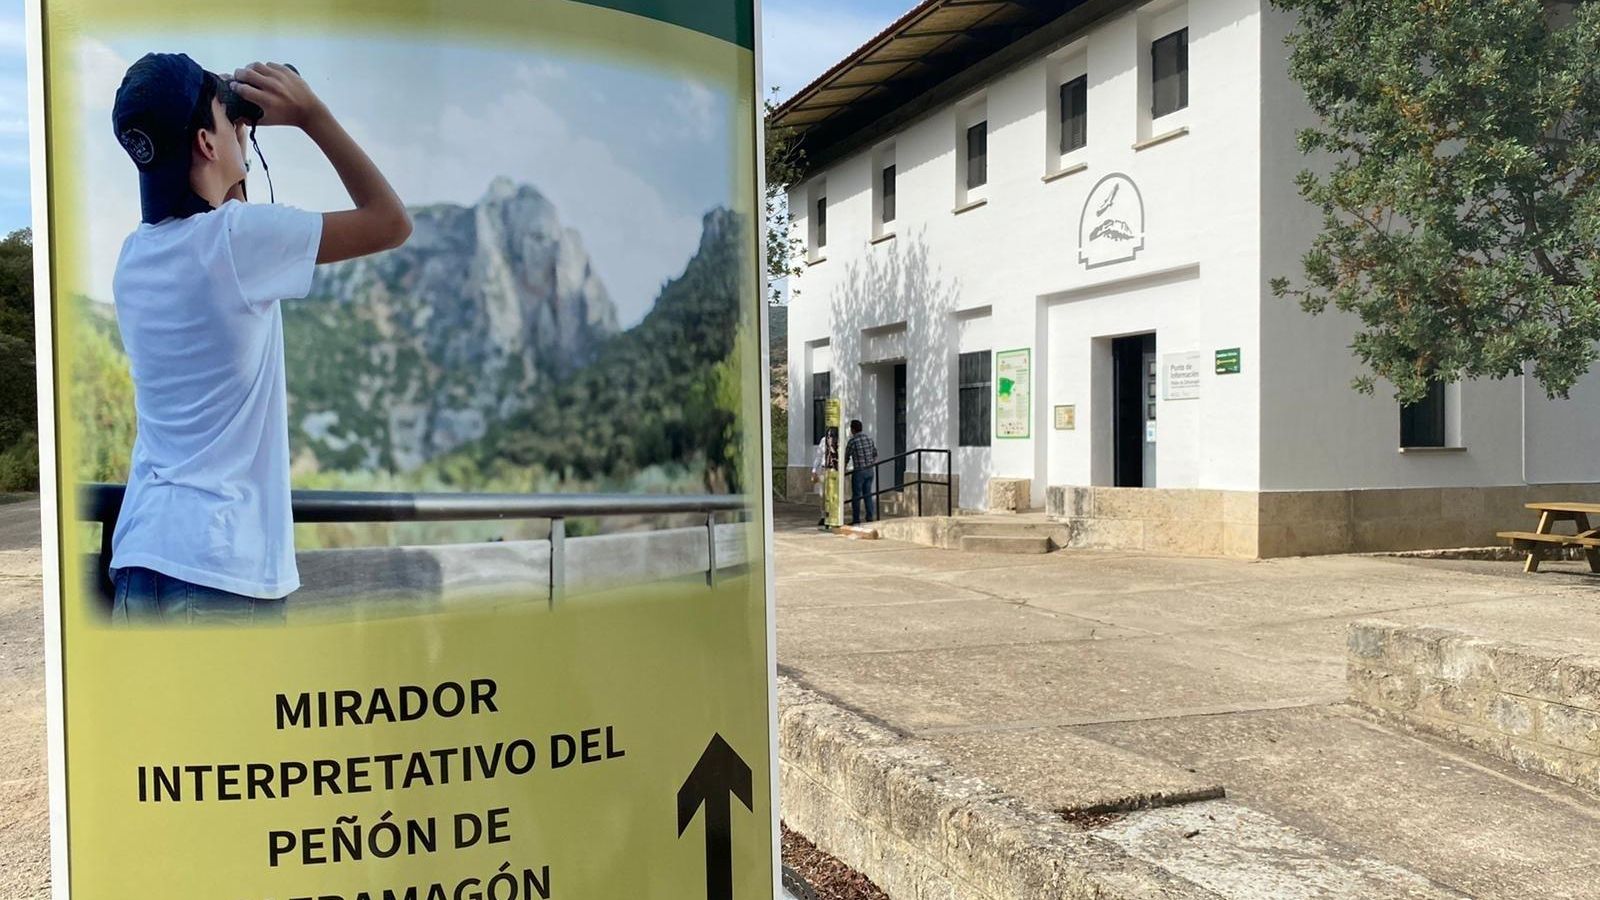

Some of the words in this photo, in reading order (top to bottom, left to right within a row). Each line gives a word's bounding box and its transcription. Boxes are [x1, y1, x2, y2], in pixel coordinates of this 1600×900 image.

[276, 679, 499, 729] MIRADOR
[138, 740, 536, 802] INTERPRETATIVO
[551, 726, 626, 770] DEL
[269, 810, 437, 867] PEÑÓN
[454, 807, 511, 849] DE
